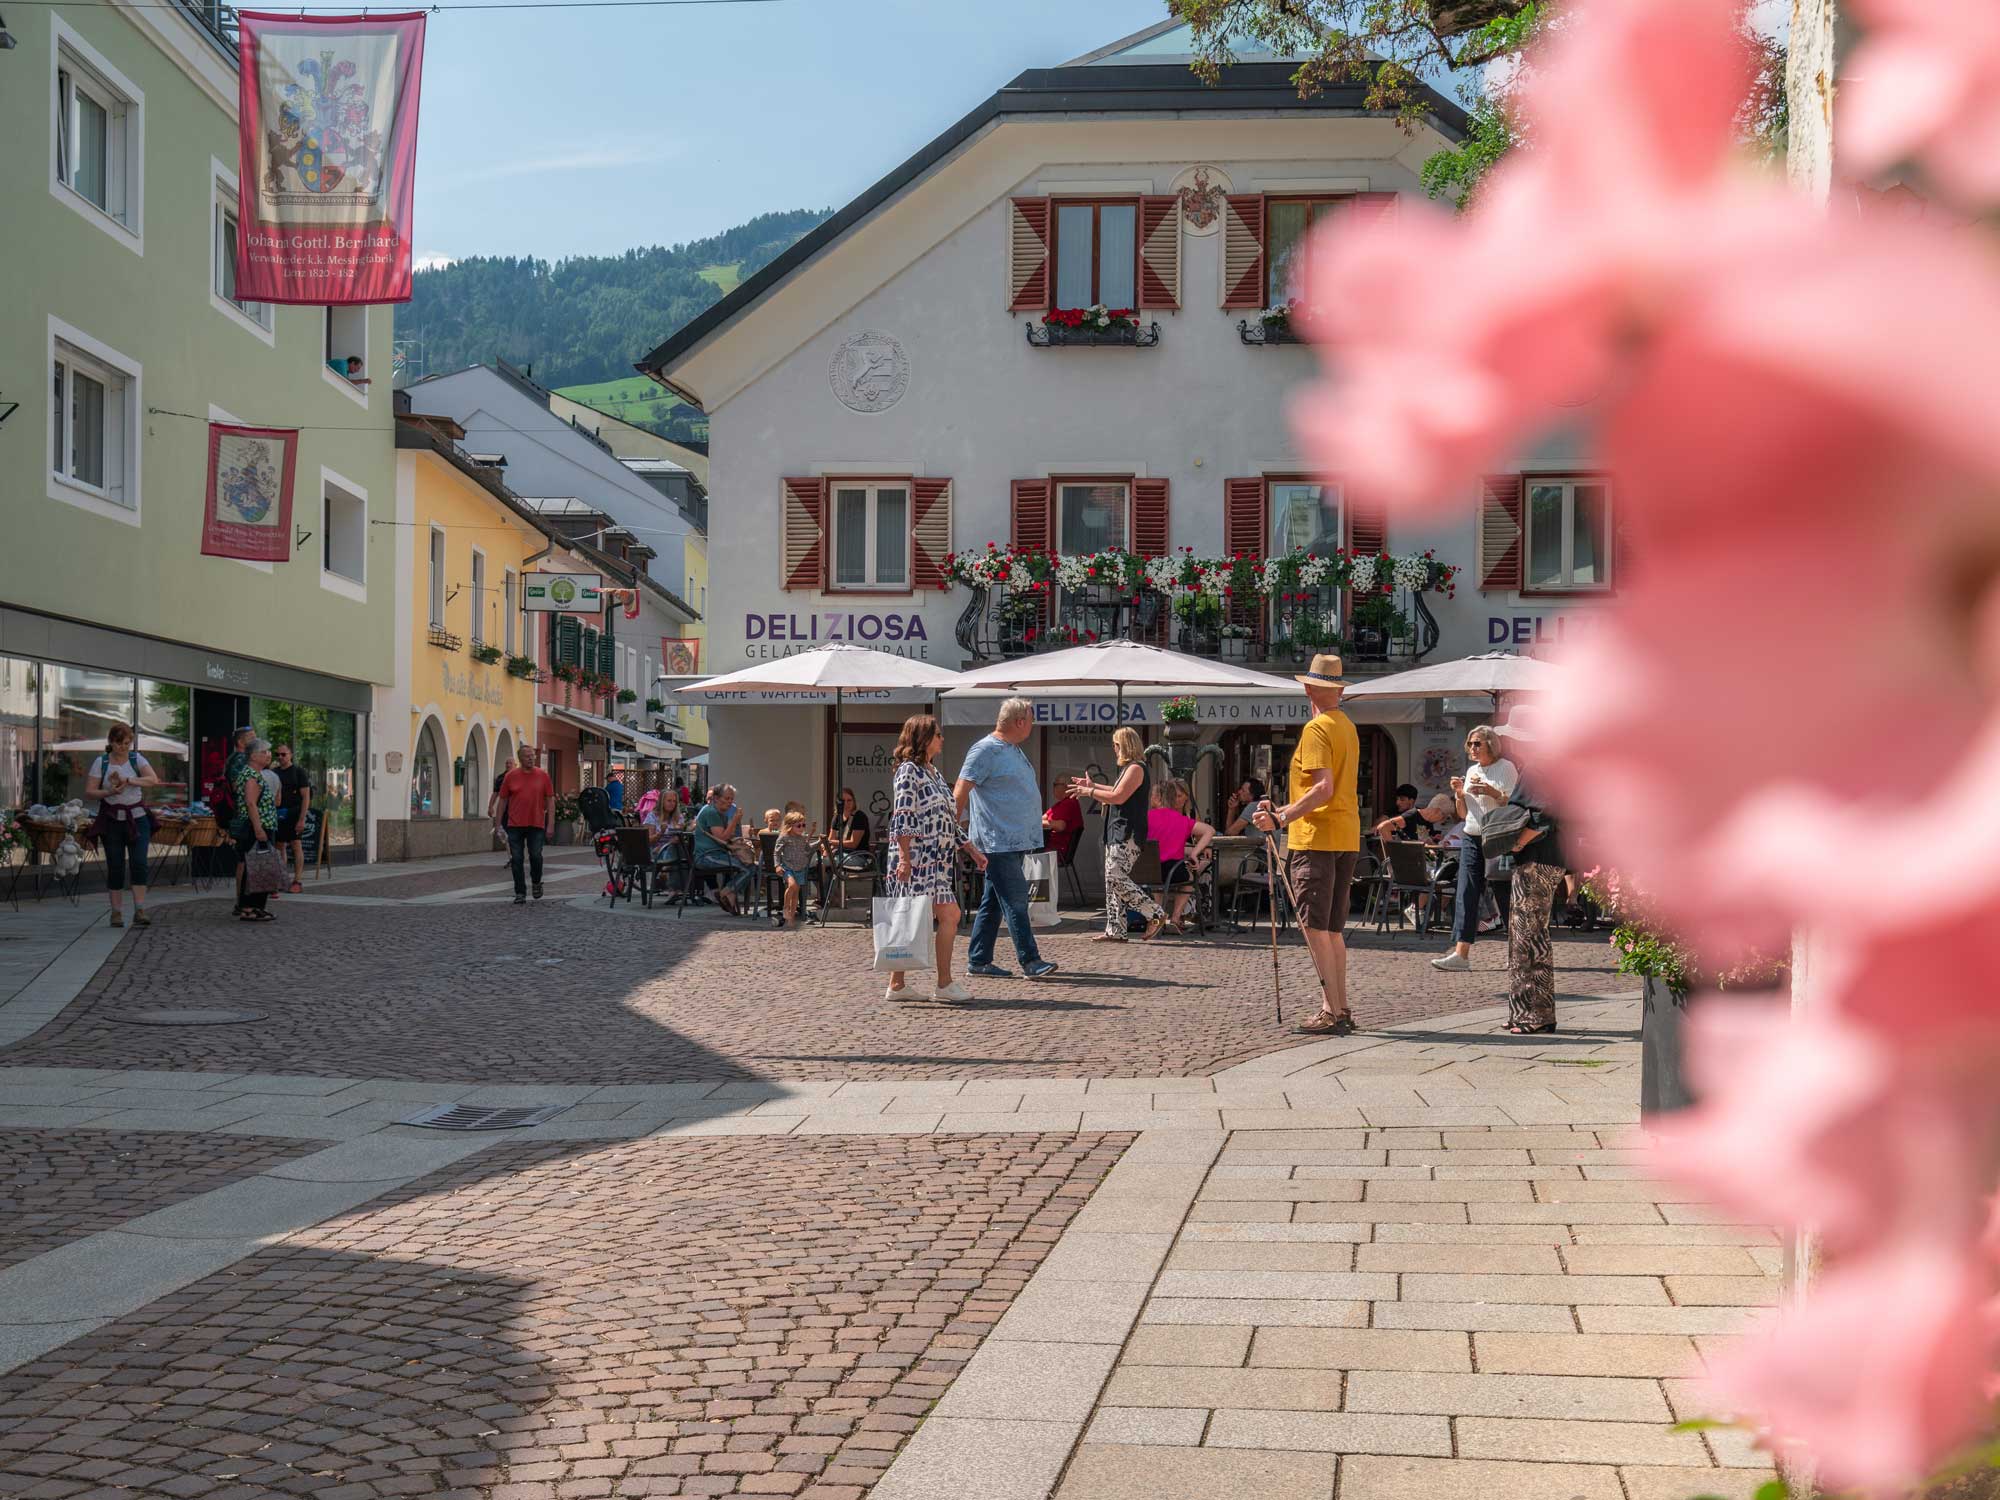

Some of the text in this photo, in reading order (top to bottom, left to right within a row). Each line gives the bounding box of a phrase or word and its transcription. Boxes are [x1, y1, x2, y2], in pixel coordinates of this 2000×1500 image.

[291, 234, 331, 249] Gottl.
[335, 233, 399, 249] Bernhard
[327, 253, 395, 267] Messingfabrik
[745, 613, 928, 641] DELIZIOSA
[1031, 703, 1147, 721] ELIZIOSA
[1197, 705, 1309, 718] LATO NATUR
[1058, 724, 1114, 734] DELIZIO
[847, 756, 896, 767] DELIZIO
